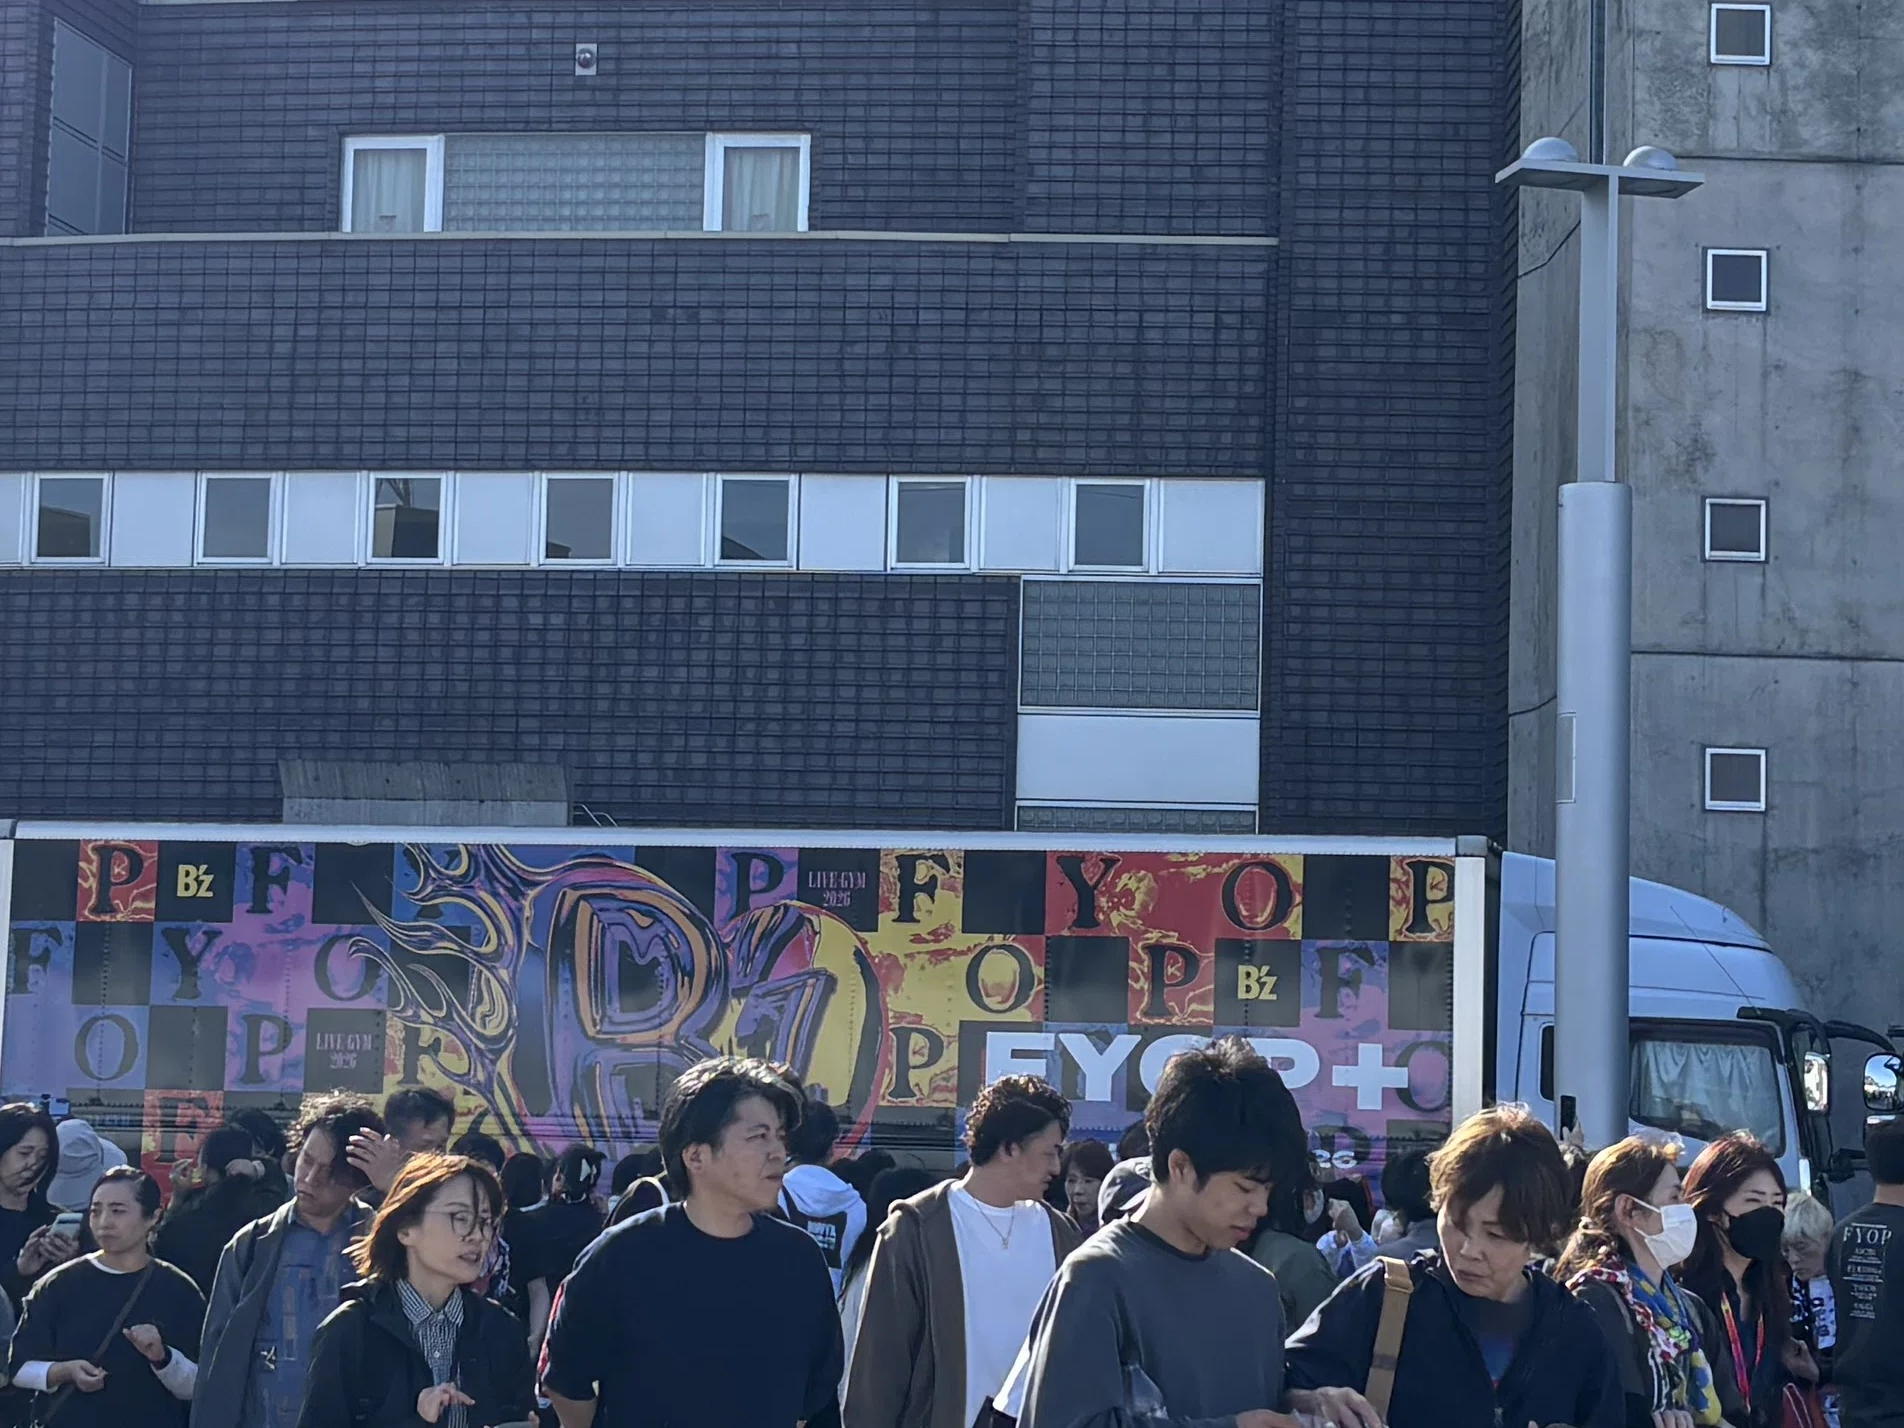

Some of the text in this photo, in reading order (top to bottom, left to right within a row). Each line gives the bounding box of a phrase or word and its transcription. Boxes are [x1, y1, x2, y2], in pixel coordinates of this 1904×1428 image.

[177, 864, 215, 898] B'z
[823, 890, 851, 907] 2026
[1237, 964, 1278, 1001] B'z
[1843, 1226, 1893, 1245] FYOP
